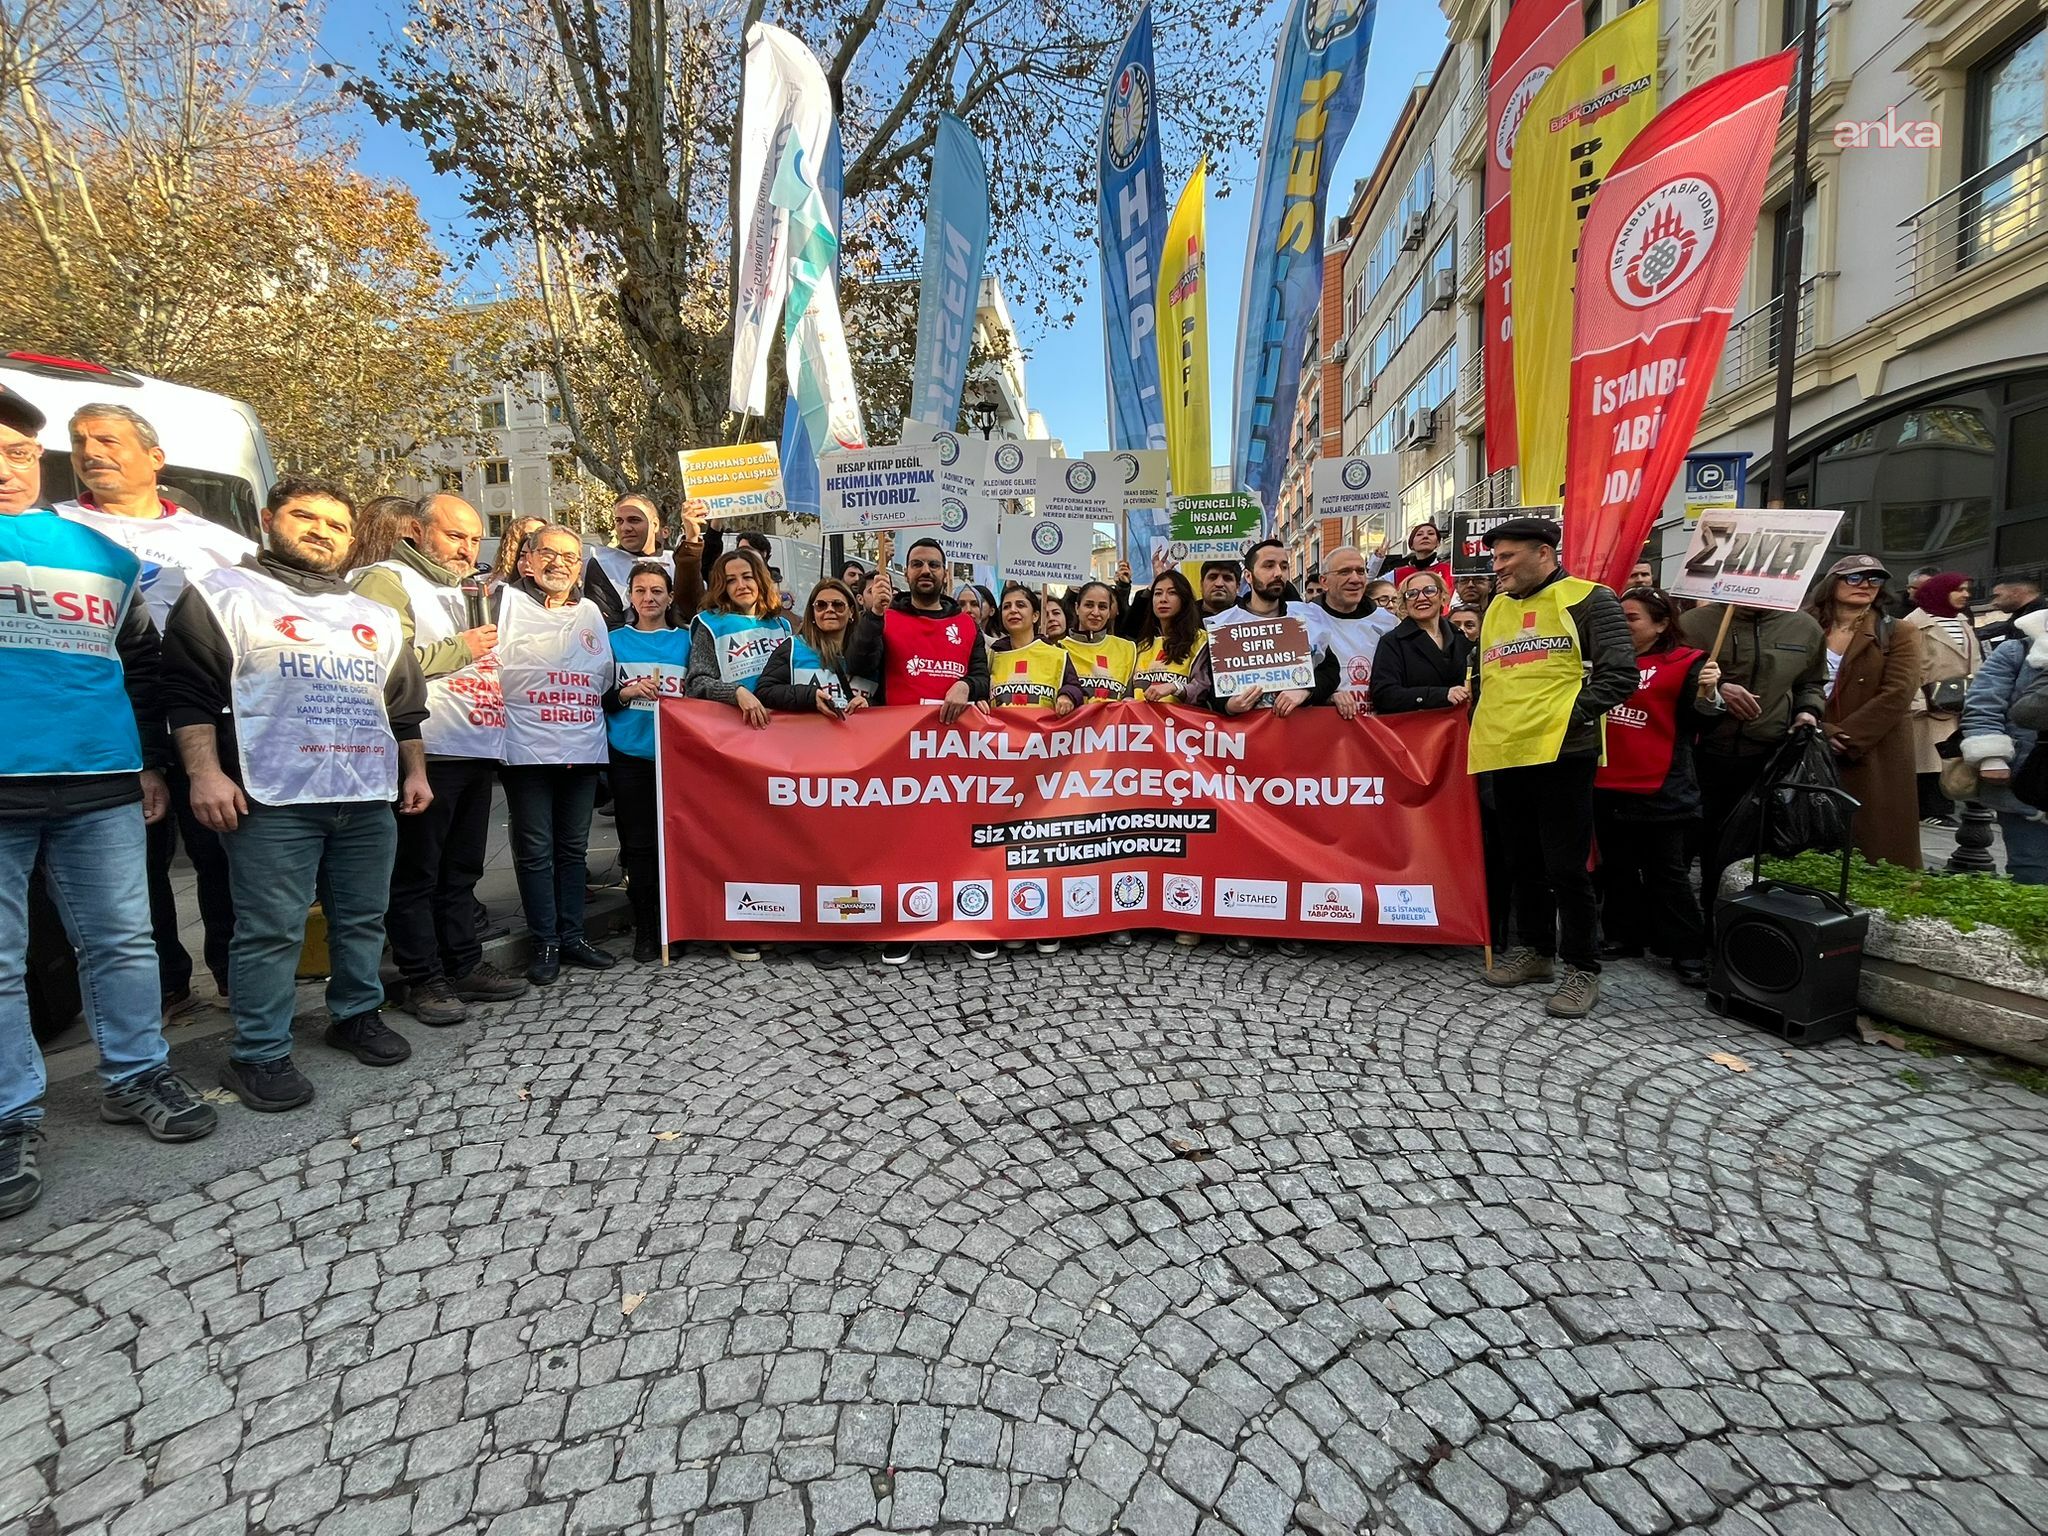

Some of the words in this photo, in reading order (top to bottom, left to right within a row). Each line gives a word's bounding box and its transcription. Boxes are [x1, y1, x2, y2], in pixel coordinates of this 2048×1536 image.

[1660, 181, 1700, 199] TABİP
[1698, 191, 1715, 231] ODASI
[685, 458, 745, 472] PERFORMANS
[836, 461, 866, 474] HESAP
[867, 459, 893, 471] KİTAP
[826, 472, 882, 491] HEKİMLİK
[884, 470, 935, 486] YAPMAK
[710, 494, 763, 509] HEP-SEN
[841, 487, 920, 509] İSTİYORUZ.
[1053, 497, 1092, 505] PERFORMANS
[1177, 496, 1235, 510] GÜVENCELİ
[1237, 496, 1251, 509] İŞ,
[871, 511, 906, 521] İSTAHED
[1190, 511, 1237, 522] İNSANCA
[1194, 525, 1233, 536] YAŞAM!
[1189, 542, 1239, 553] HEP-SEN
[1037, 561, 1072, 570] PARAMETRE
[1722, 583, 1760, 594] İSTAHED
[1230, 623, 1284, 641] ŞİDDETE
[1242, 639, 1275, 652] SIFIR
[1224, 651, 1297, 668] TOLERANS!
[547, 670, 591, 688] TÜRK
[1236, 670, 1291, 684] HEP-SEN
[297, 706, 323, 714] KAMU
[910, 725, 1153, 760] HAKLARIMIZ
[1164, 718, 1246, 762] İÇİN
[299, 743, 385, 756] www.hekimsen.org
[767, 774, 1025, 808] BURADAYIZ,
[1035, 765, 1385, 807] VAZGEÇMİYORUZ!
[973, 825, 1005, 844] SİZ
[1009, 813, 1211, 841] YÖNETEMİYORSUNUZ
[1007, 845, 1040, 866] BİZ
[1043, 837, 1181, 864] TÜKENİYORUZ!
[1236, 891, 1278, 904] İSTAHED
[1312, 903, 1350, 912] İSTANBUL
[1397, 905, 1432, 914] İSTANBUL
[1307, 910, 1329, 919] TABİP
[1330, 911, 1355, 919] ODASI
[1391, 912, 1426, 921] ŞUBELERİ
